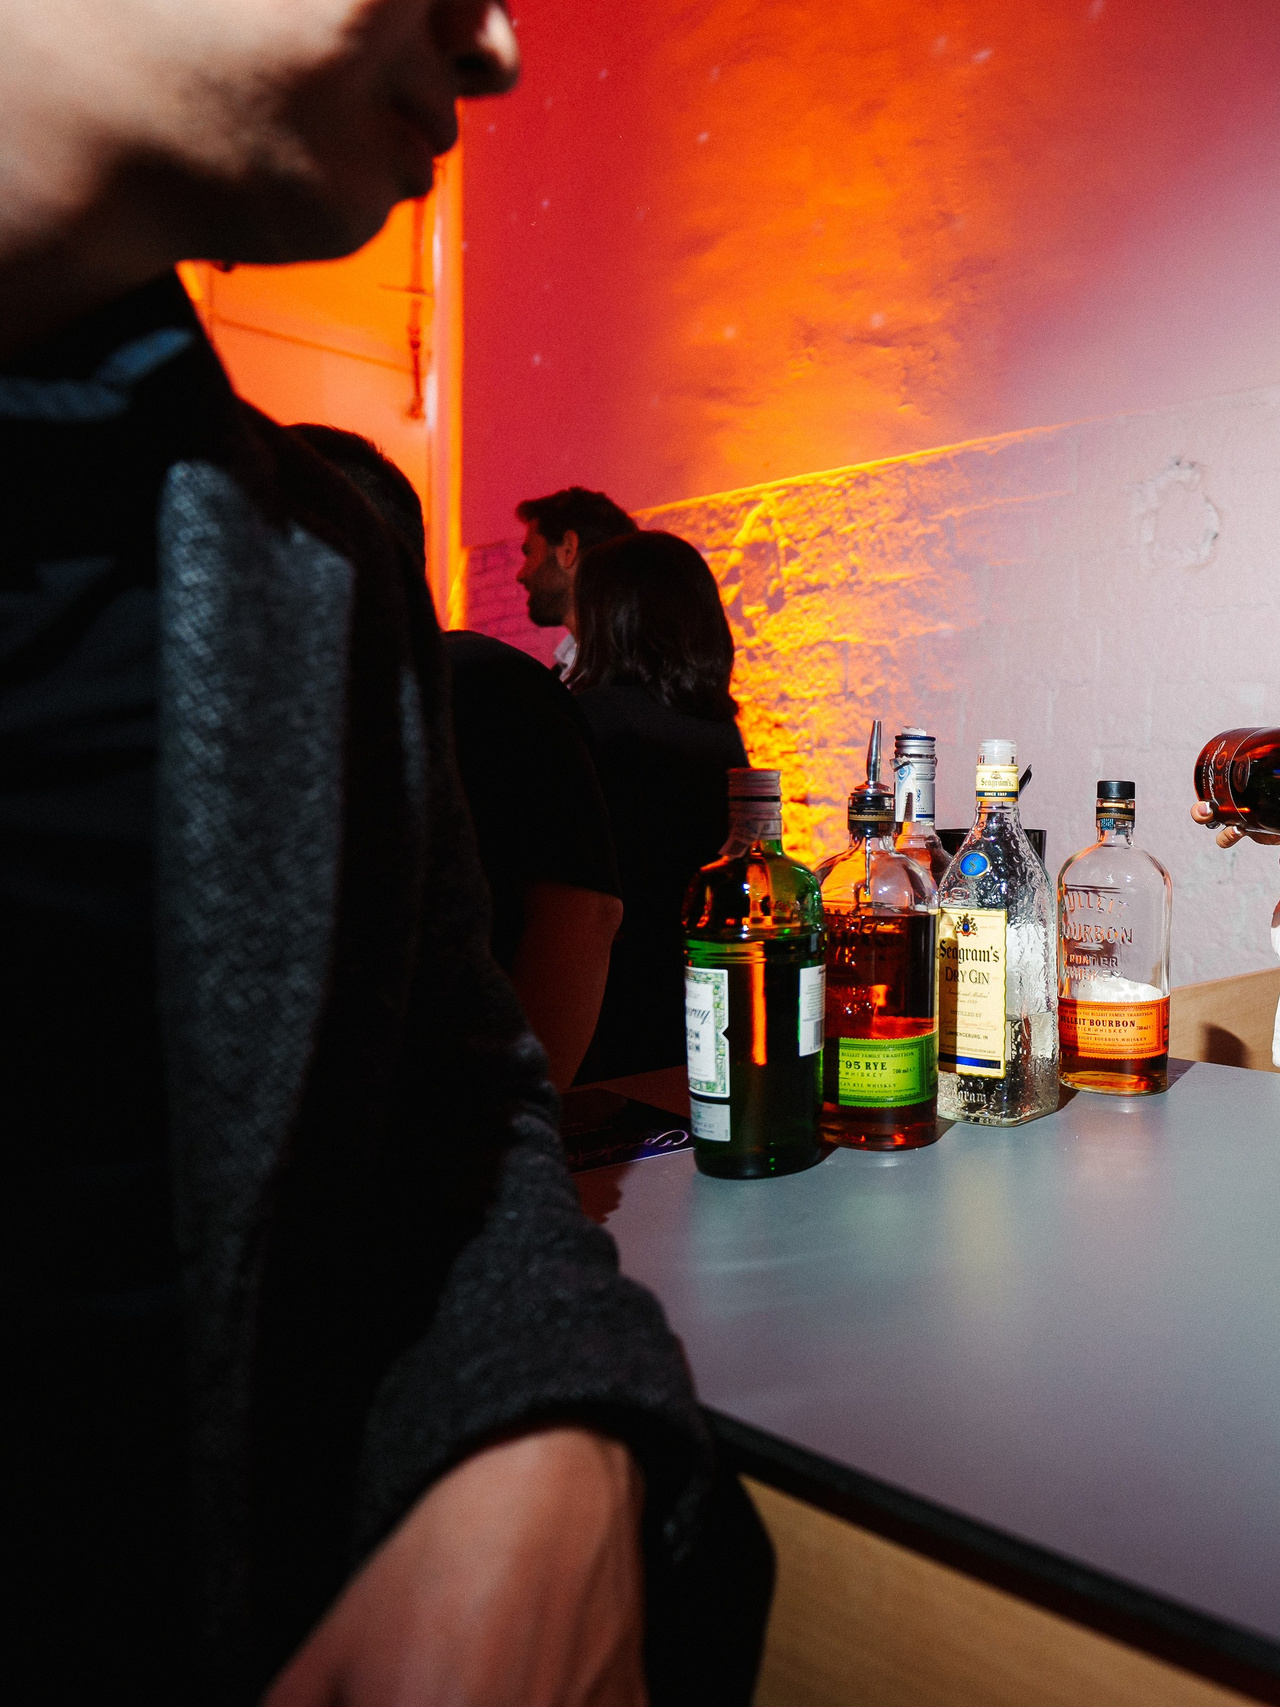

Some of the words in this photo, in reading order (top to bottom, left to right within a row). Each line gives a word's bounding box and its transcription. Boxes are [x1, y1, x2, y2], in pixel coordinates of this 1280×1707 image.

[940, 939, 1000, 964] Seagram's
[945, 966, 967, 983] DRY
[969, 968, 990, 986] GIN
[1089, 1018, 1136, 1028] BOURBON
[845, 1060, 861, 1070] 95
[865, 1061, 887, 1071] RYE
